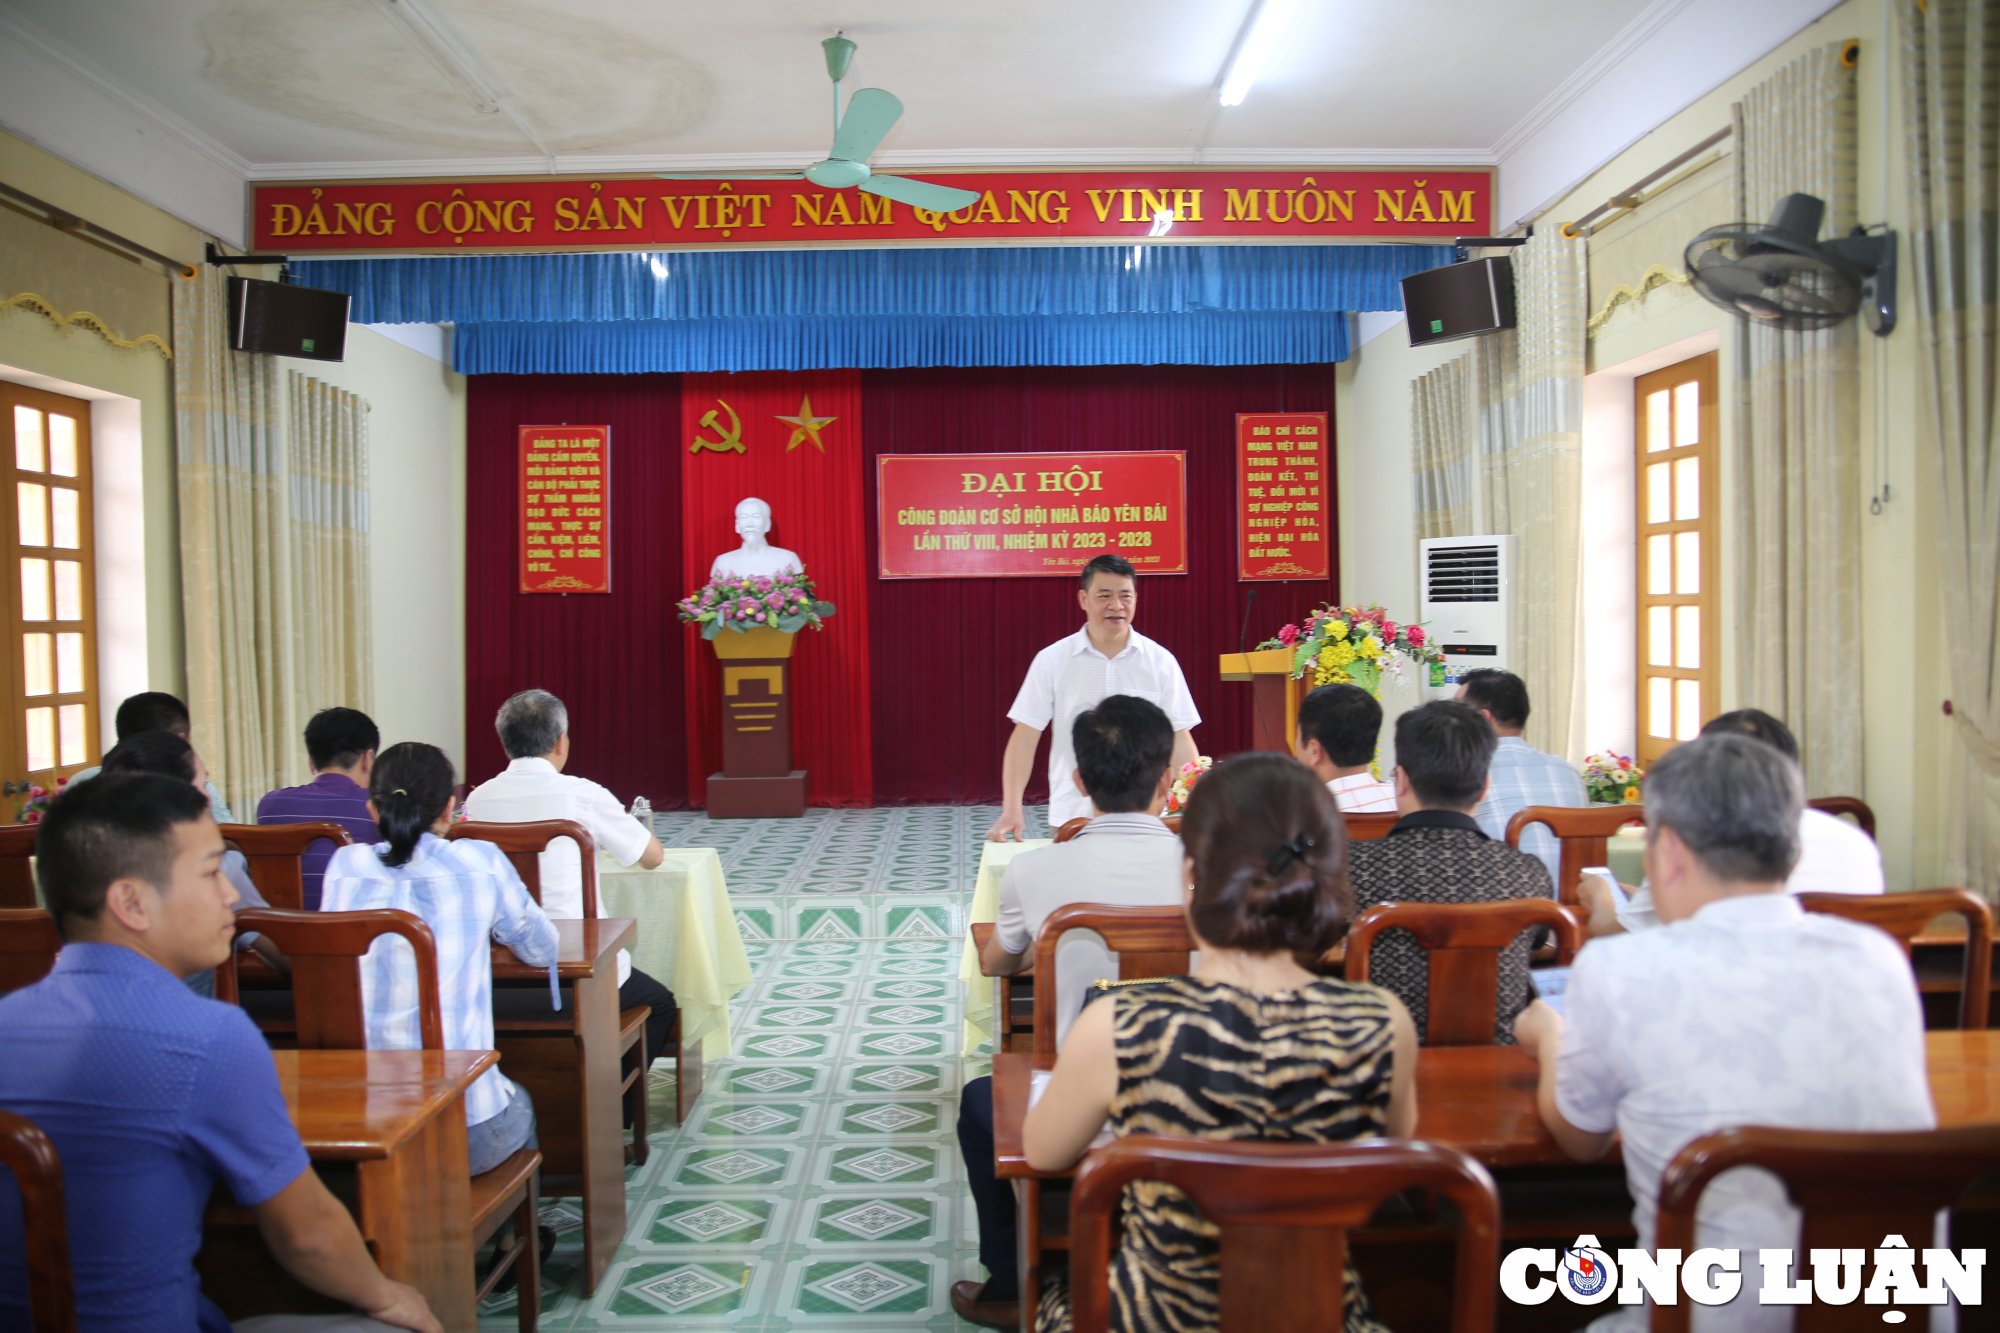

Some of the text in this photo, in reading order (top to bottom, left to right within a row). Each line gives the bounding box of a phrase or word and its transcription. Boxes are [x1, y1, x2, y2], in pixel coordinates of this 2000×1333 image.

[270, 188, 396, 236] ĐẢNG
[415, 188, 535, 244] CỘNG
[554, 182, 647, 232] SẢN
[660, 182, 771, 238] VIỆT
[791, 192, 895, 227] NAM
[1084, 188, 1203, 223] VINH
[1224, 176, 1356, 223] MUÔN
[1373, 179, 1476, 223] NĂM
[960, 464, 1103, 498] ĐẠI HỘI
[898, 503, 1167, 527] CÔNG ĐOÀN CƠ SỞ HỘI NHÀ BÁO YÊN BÁI
[913, 530, 941, 550] LẦN
[944, 531, 972, 550] THỨ
[1003, 530, 1048, 552] NHIỆM
[1052, 530, 1069, 548] KỲ
[1072, 532, 1106, 548] 2023
[1119, 531, 1152, 547] 2028
